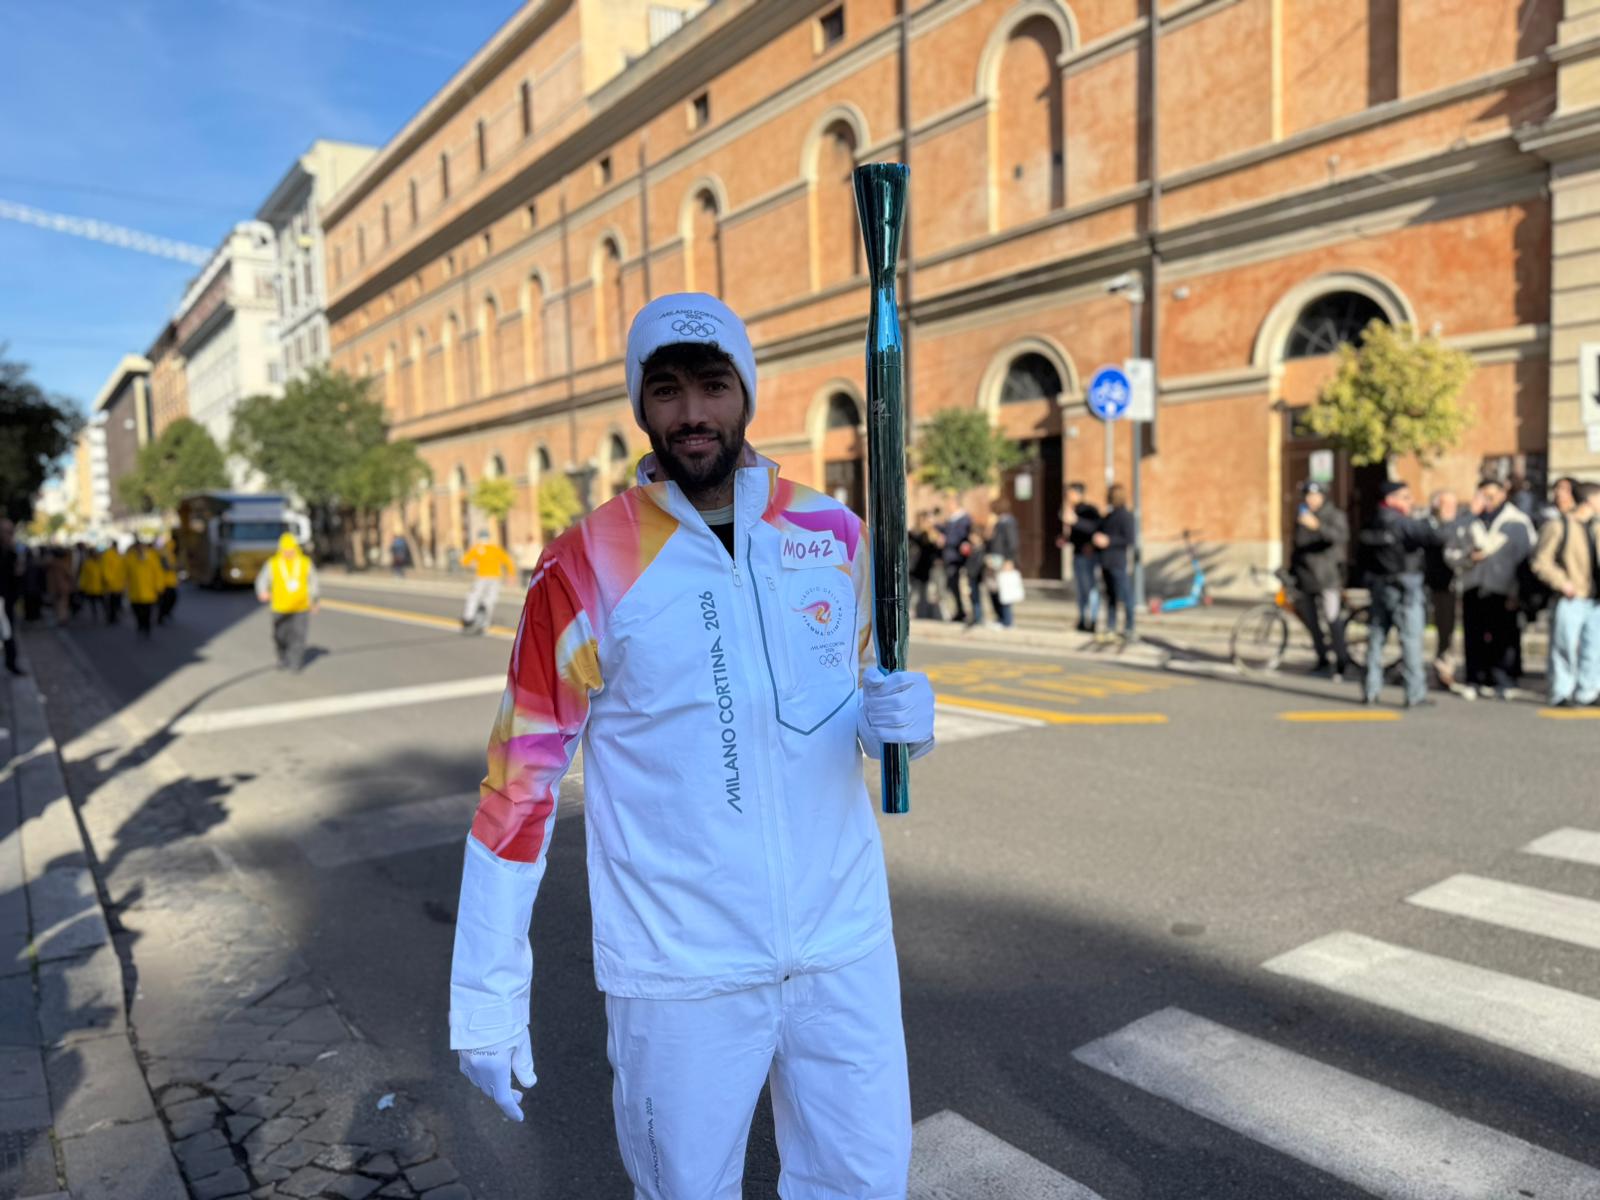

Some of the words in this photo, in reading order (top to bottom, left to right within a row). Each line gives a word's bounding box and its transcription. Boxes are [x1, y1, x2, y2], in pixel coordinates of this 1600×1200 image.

[657, 309, 693, 319] MILANO
[698, 590, 720, 631] 2026
[710, 635, 734, 725] CORTINA
[721, 728, 742, 814] MILANO
[648, 1118, 657, 1155] CORTINA
